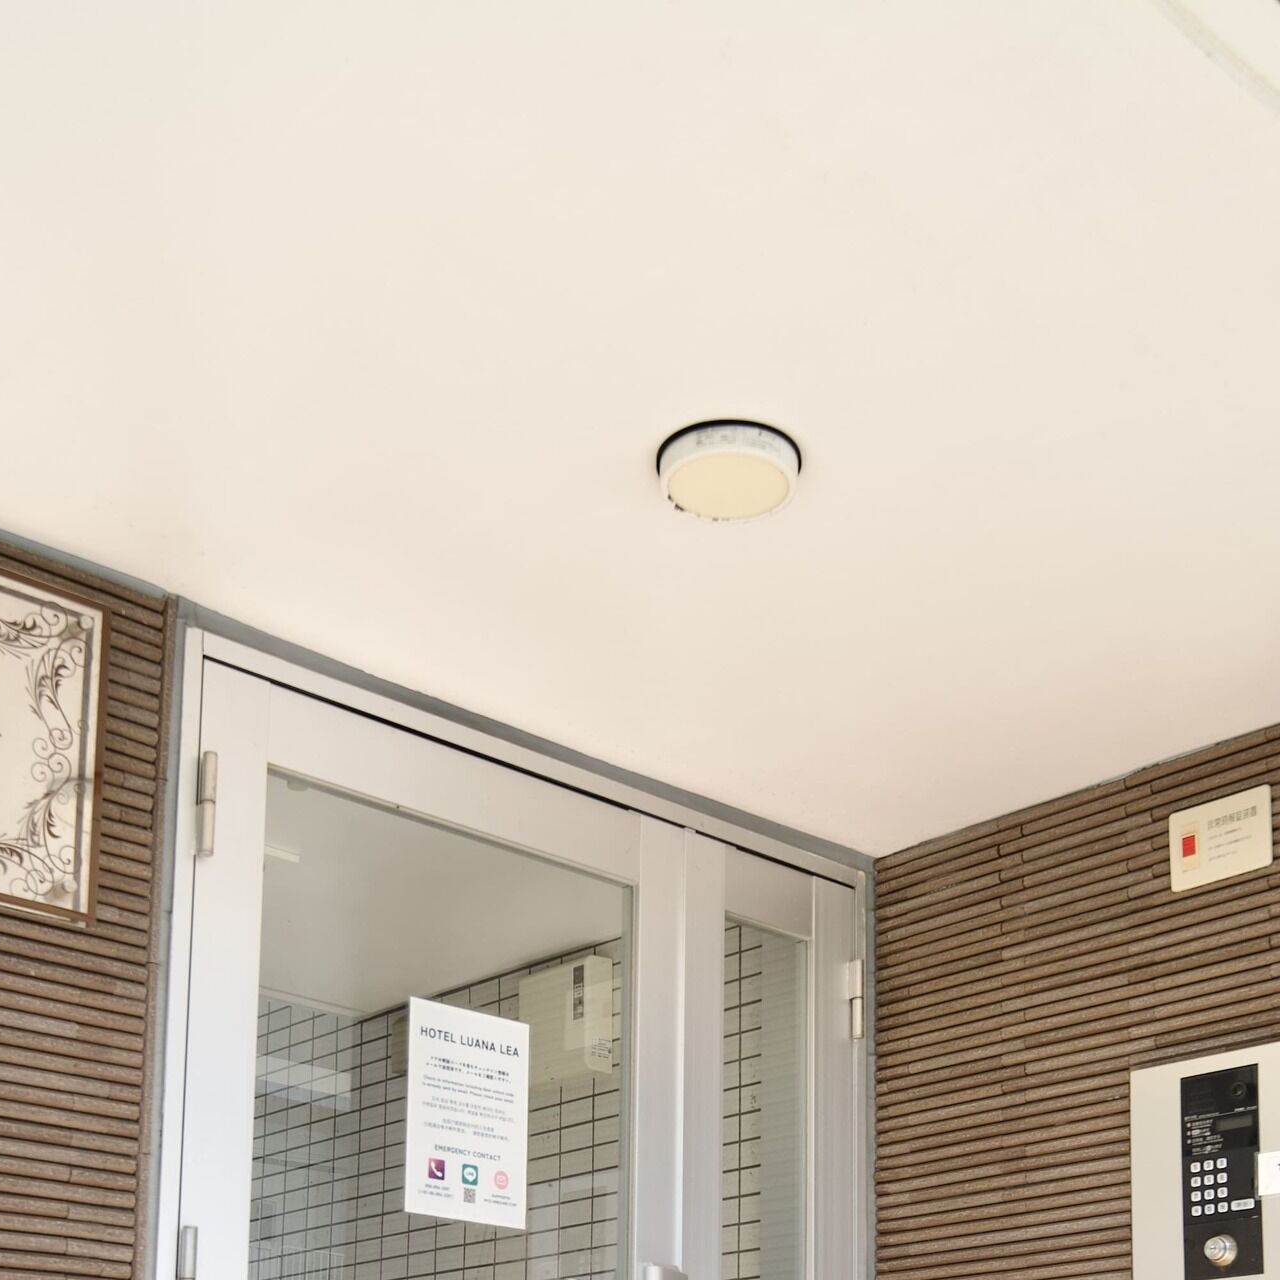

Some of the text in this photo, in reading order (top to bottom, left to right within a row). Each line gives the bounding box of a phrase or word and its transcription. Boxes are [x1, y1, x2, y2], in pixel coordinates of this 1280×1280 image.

[420, 1026, 520, 1058] HOTEL LUANA LEA
[434, 1144, 502, 1162] EMERGENCY CONTACT
